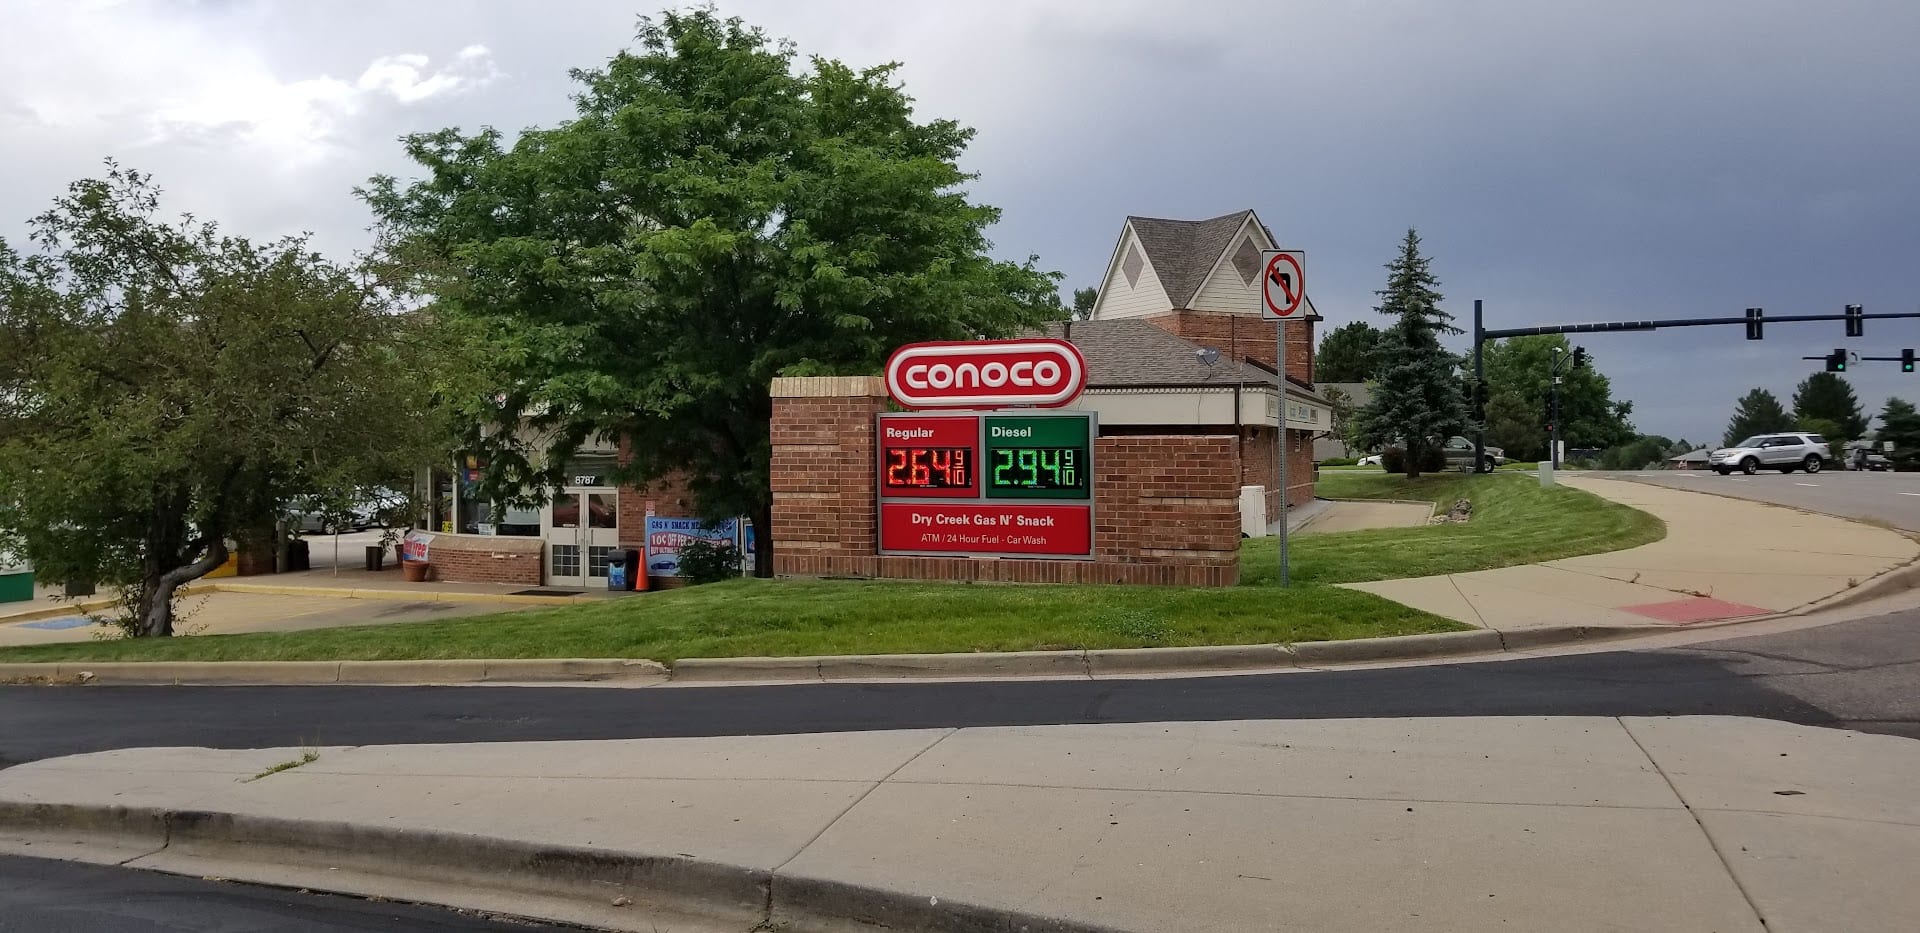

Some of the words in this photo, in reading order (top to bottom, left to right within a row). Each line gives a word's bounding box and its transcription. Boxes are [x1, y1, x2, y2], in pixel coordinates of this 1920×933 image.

[886, 427, 934, 440] Regular
[991, 426, 1032, 438] Diesel
[575, 475, 595, 484] 8787
[651, 520, 663, 529] GAS
[671, 521, 690, 530] SNACK
[912, 513, 932, 526] Dry
[936, 513, 970, 525] Creek
[974, 514, 996, 526] Gas
[1016, 515, 1054, 527] Snack
[667, 533, 678, 547] OFF
[921, 533, 940, 542] ATM
[947, 534, 957, 542] 24
[959, 534, 979, 544] Hour
[981, 535, 999, 544] Fuel
[1007, 535, 1021, 544] Car
[1023, 535, 1047, 545] Wash
